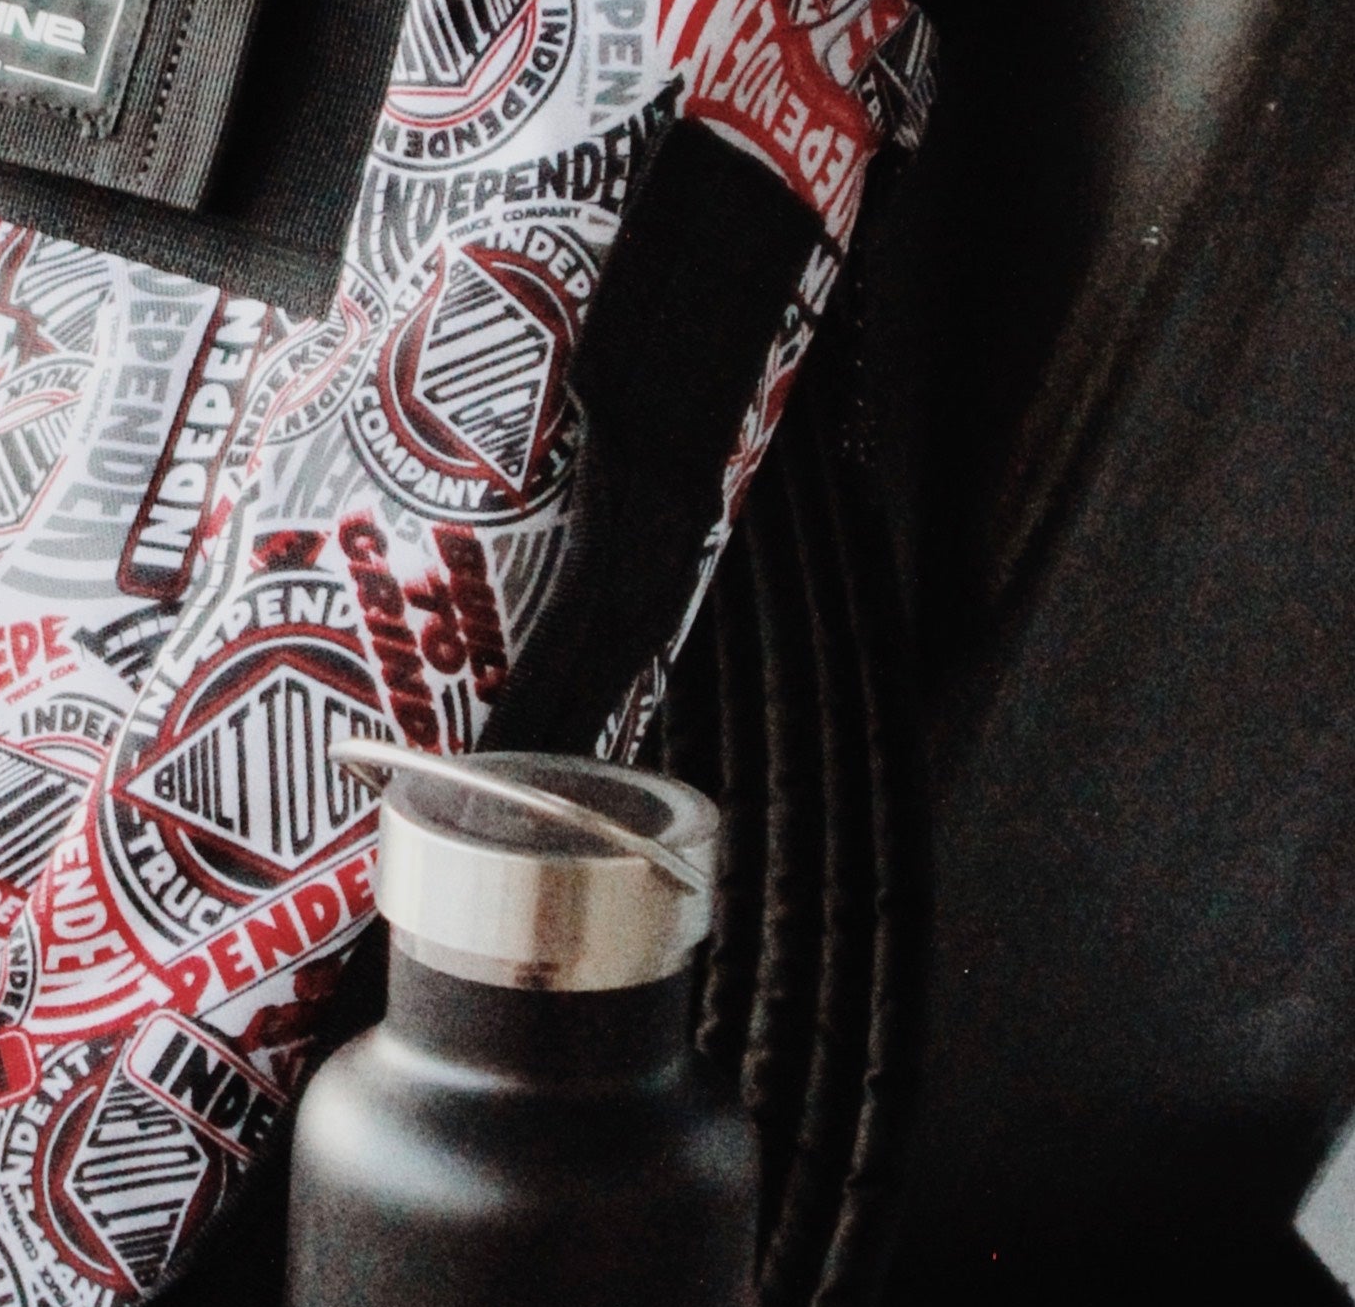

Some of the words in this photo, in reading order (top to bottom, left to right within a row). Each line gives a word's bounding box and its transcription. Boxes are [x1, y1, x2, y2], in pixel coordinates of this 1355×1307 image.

[446, 217, 493, 243] TRUCK
[502, 205, 582, 221] COMPANY
[132, 296, 269, 568] INDEPEN
[356, 387, 490, 509] COMPANY
[153, 701, 252, 841] BUILT
[259, 675, 316, 858] TO
